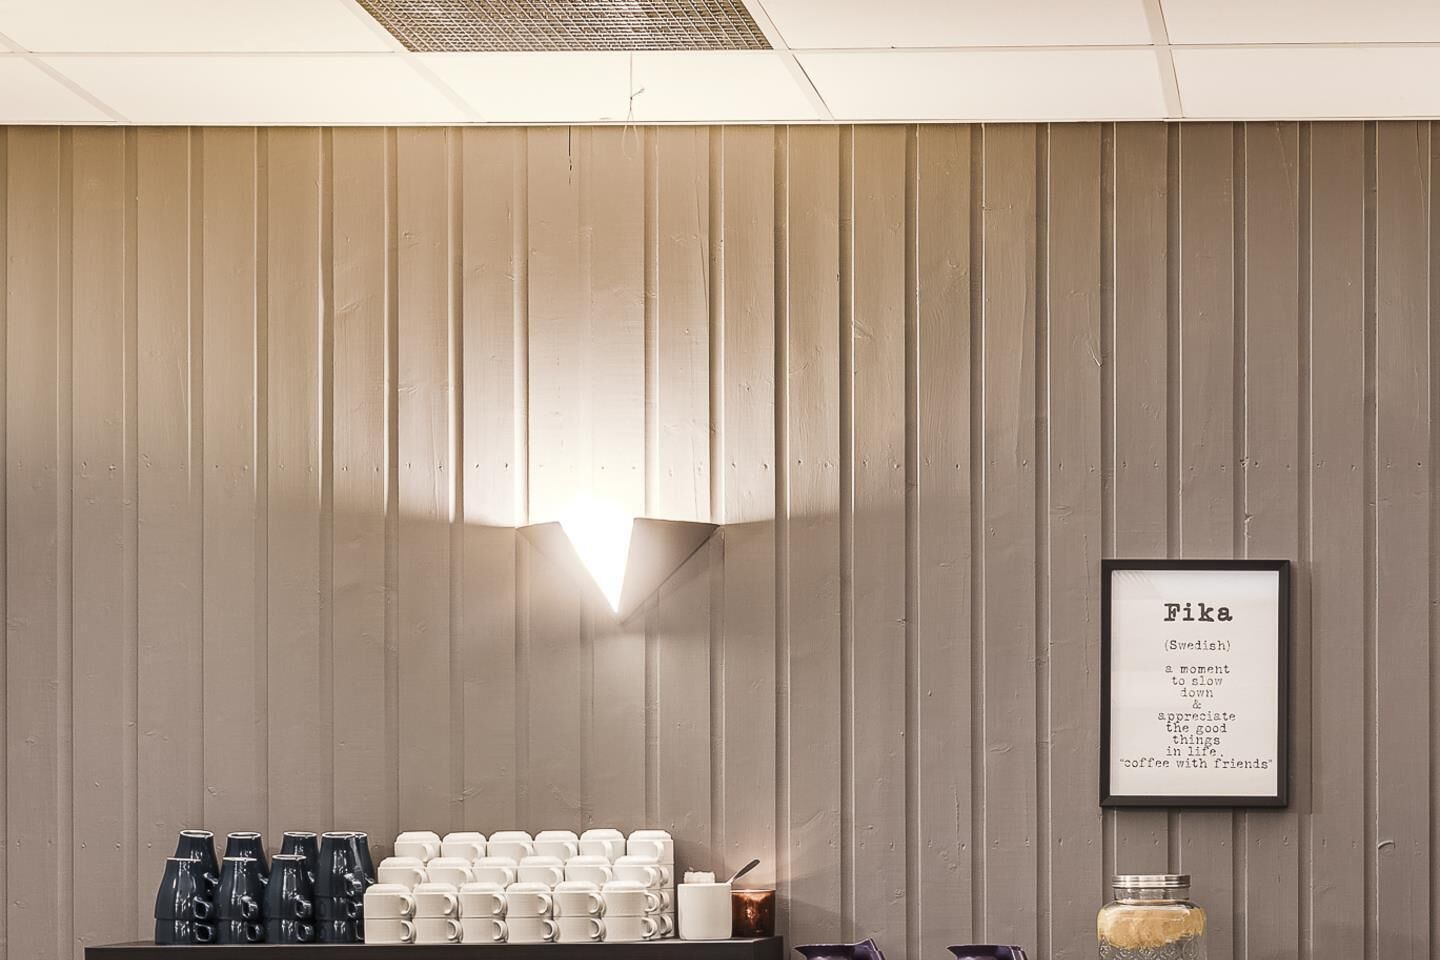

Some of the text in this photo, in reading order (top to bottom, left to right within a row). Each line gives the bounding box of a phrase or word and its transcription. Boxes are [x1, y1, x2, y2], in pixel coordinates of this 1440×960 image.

[1164, 603, 1233, 622] Fika
[1165, 640, 1230, 652] (Swedish)
[1164, 665, 1230, 674] a moment
[1172, 676, 1222, 686] to slow
[1181, 688, 1213, 698] down
[1192, 699, 1201, 709] &
[1158, 711, 1236, 724] appreciate
[1166, 723, 1227, 735] the good
[1173, 735, 1220, 746] things
[1166, 746, 1223, 756] in life.
[1176, 758, 1208, 768] with
